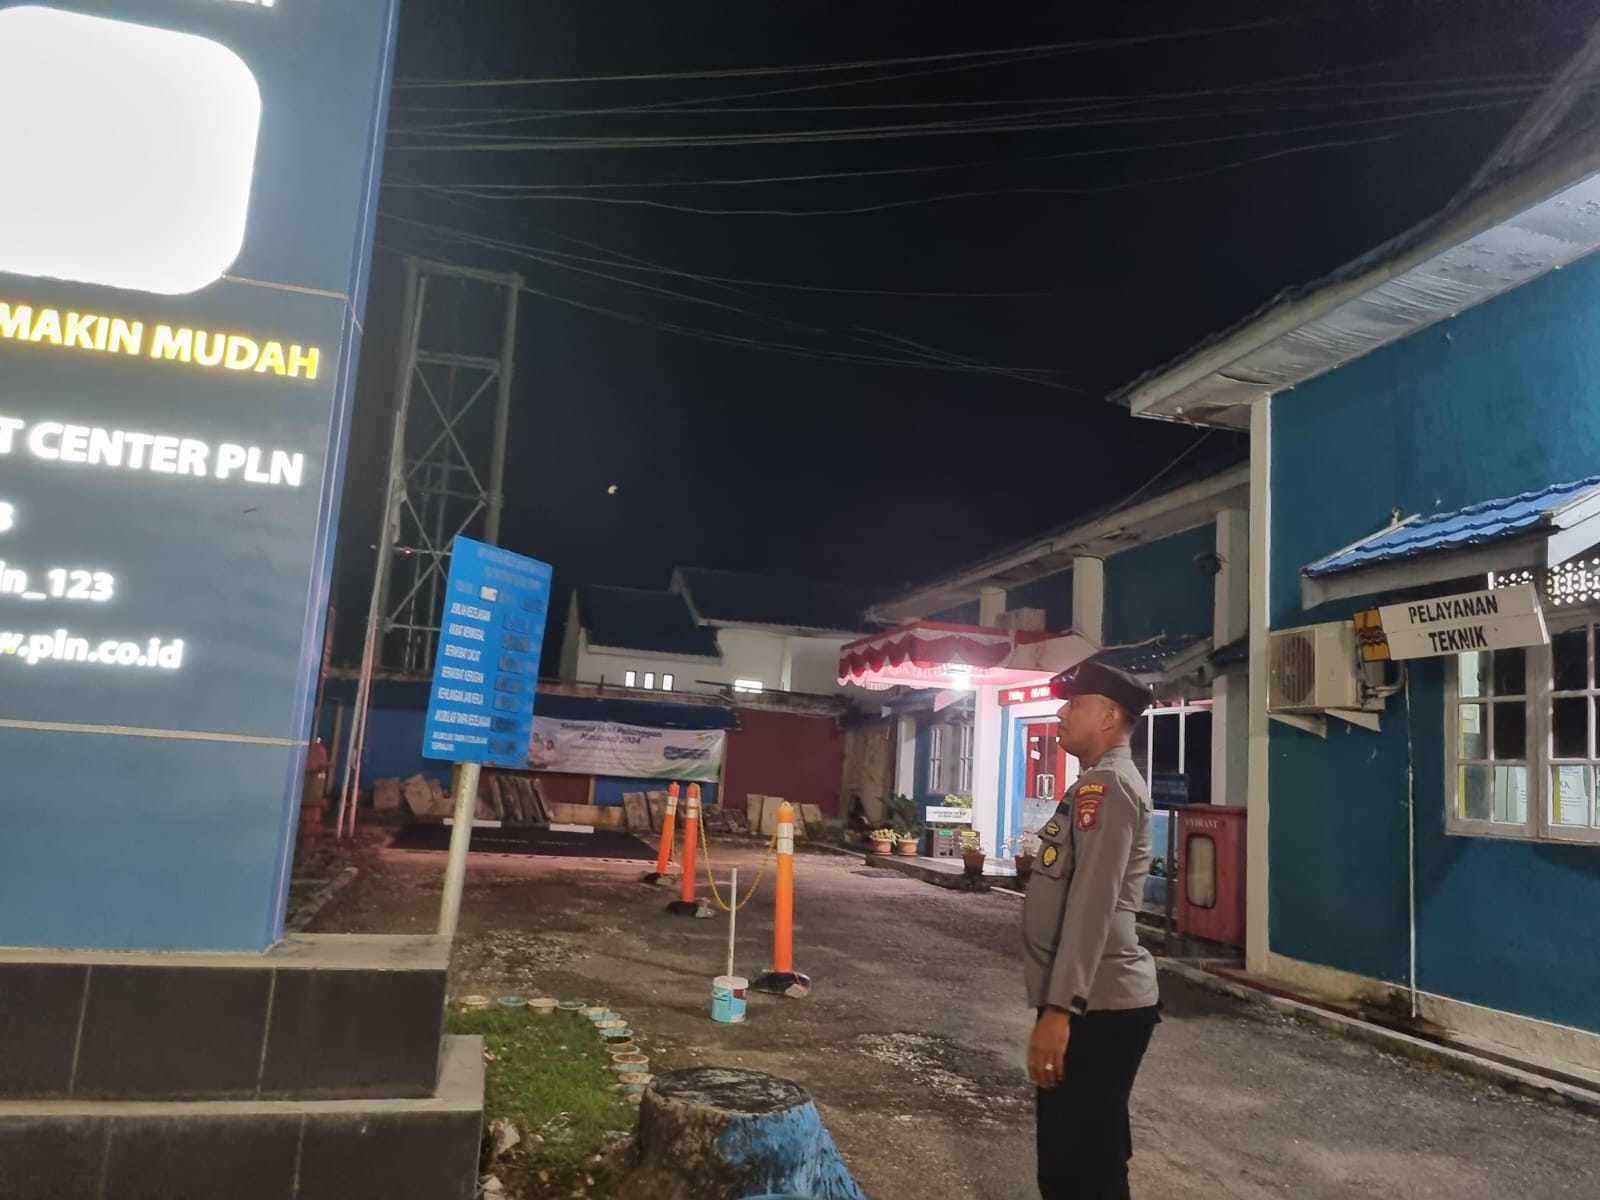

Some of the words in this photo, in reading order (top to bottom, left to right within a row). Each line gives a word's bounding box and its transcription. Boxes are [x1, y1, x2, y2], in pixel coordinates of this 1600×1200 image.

[0, 303, 144, 355] MAKIN
[150, 325, 320, 380] MUDAH
[29, 422, 209, 477] CENTER
[215, 444, 304, 487] PLN
[1408, 594, 1498, 624] PELAYANAN
[1428, 625, 1488, 653] TEKNIK
